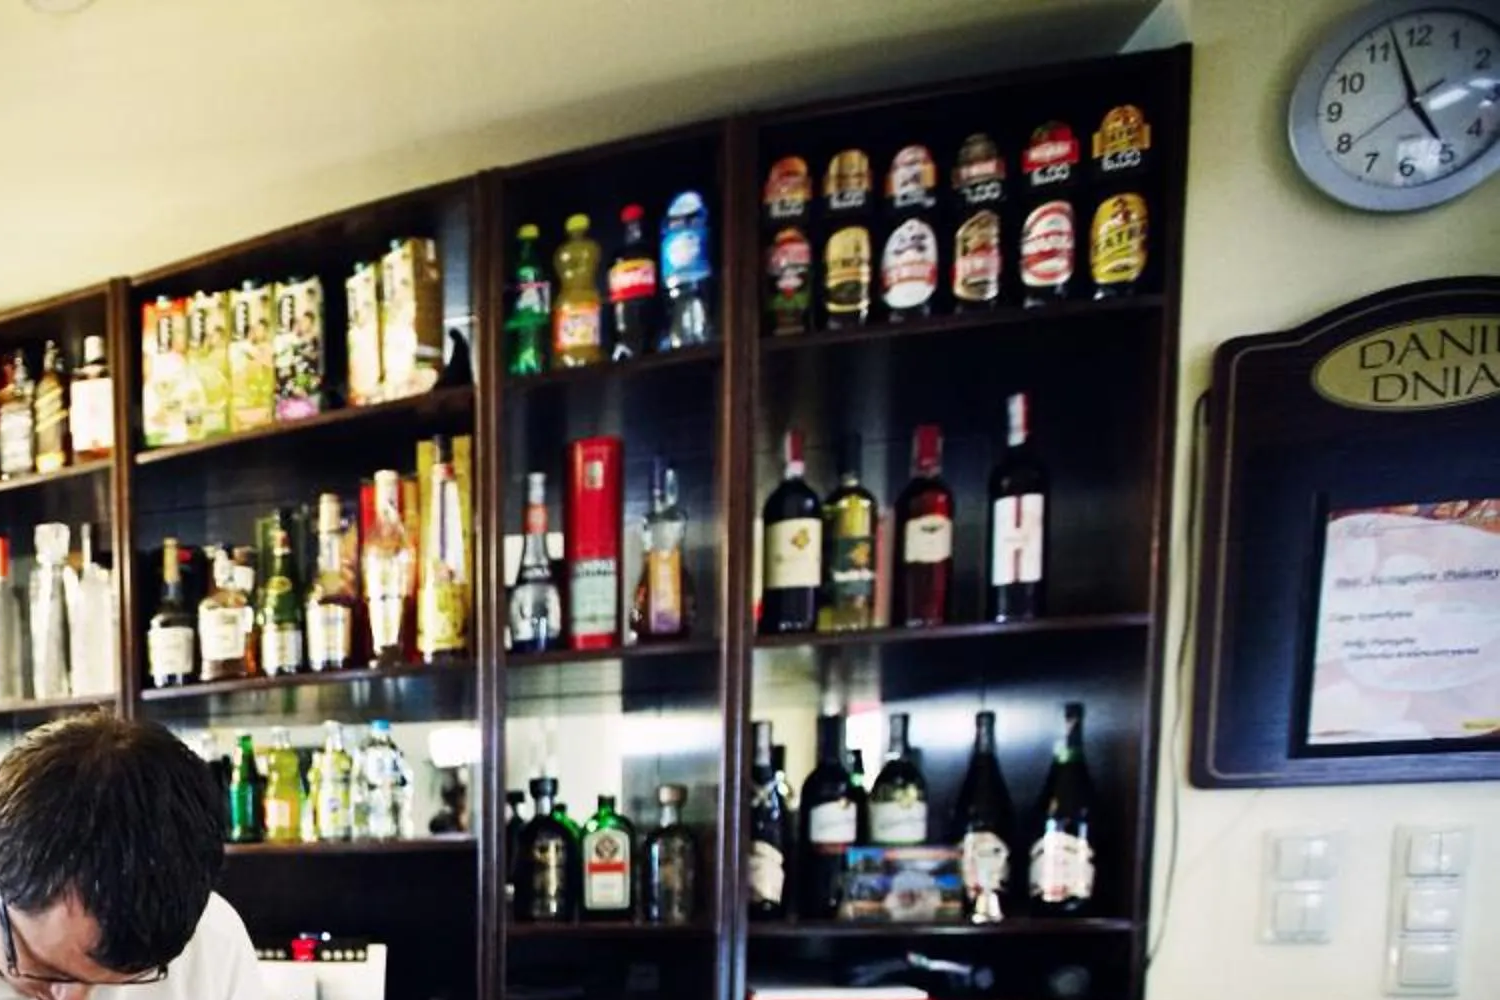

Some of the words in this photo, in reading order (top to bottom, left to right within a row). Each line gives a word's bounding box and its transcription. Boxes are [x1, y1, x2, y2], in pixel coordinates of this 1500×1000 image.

[1405, 24, 1433, 48] 12
[1449, 29, 1460, 50] 1
[1366, 41, 1390, 64] 11
[1474, 46, 1492, 70] 2
[1337, 72, 1365, 95] 10
[1327, 102, 1343, 123] 9
[1465, 117, 1483, 137] 4
[1337, 133, 1352, 154] 8
[1439, 143, 1455, 165] 5
[1365, 152, 1380, 173] 7
[1399, 156, 1415, 177] 6
[1359, 324, 1500, 369] DANI
[1373, 362, 1500, 402] DNIA
